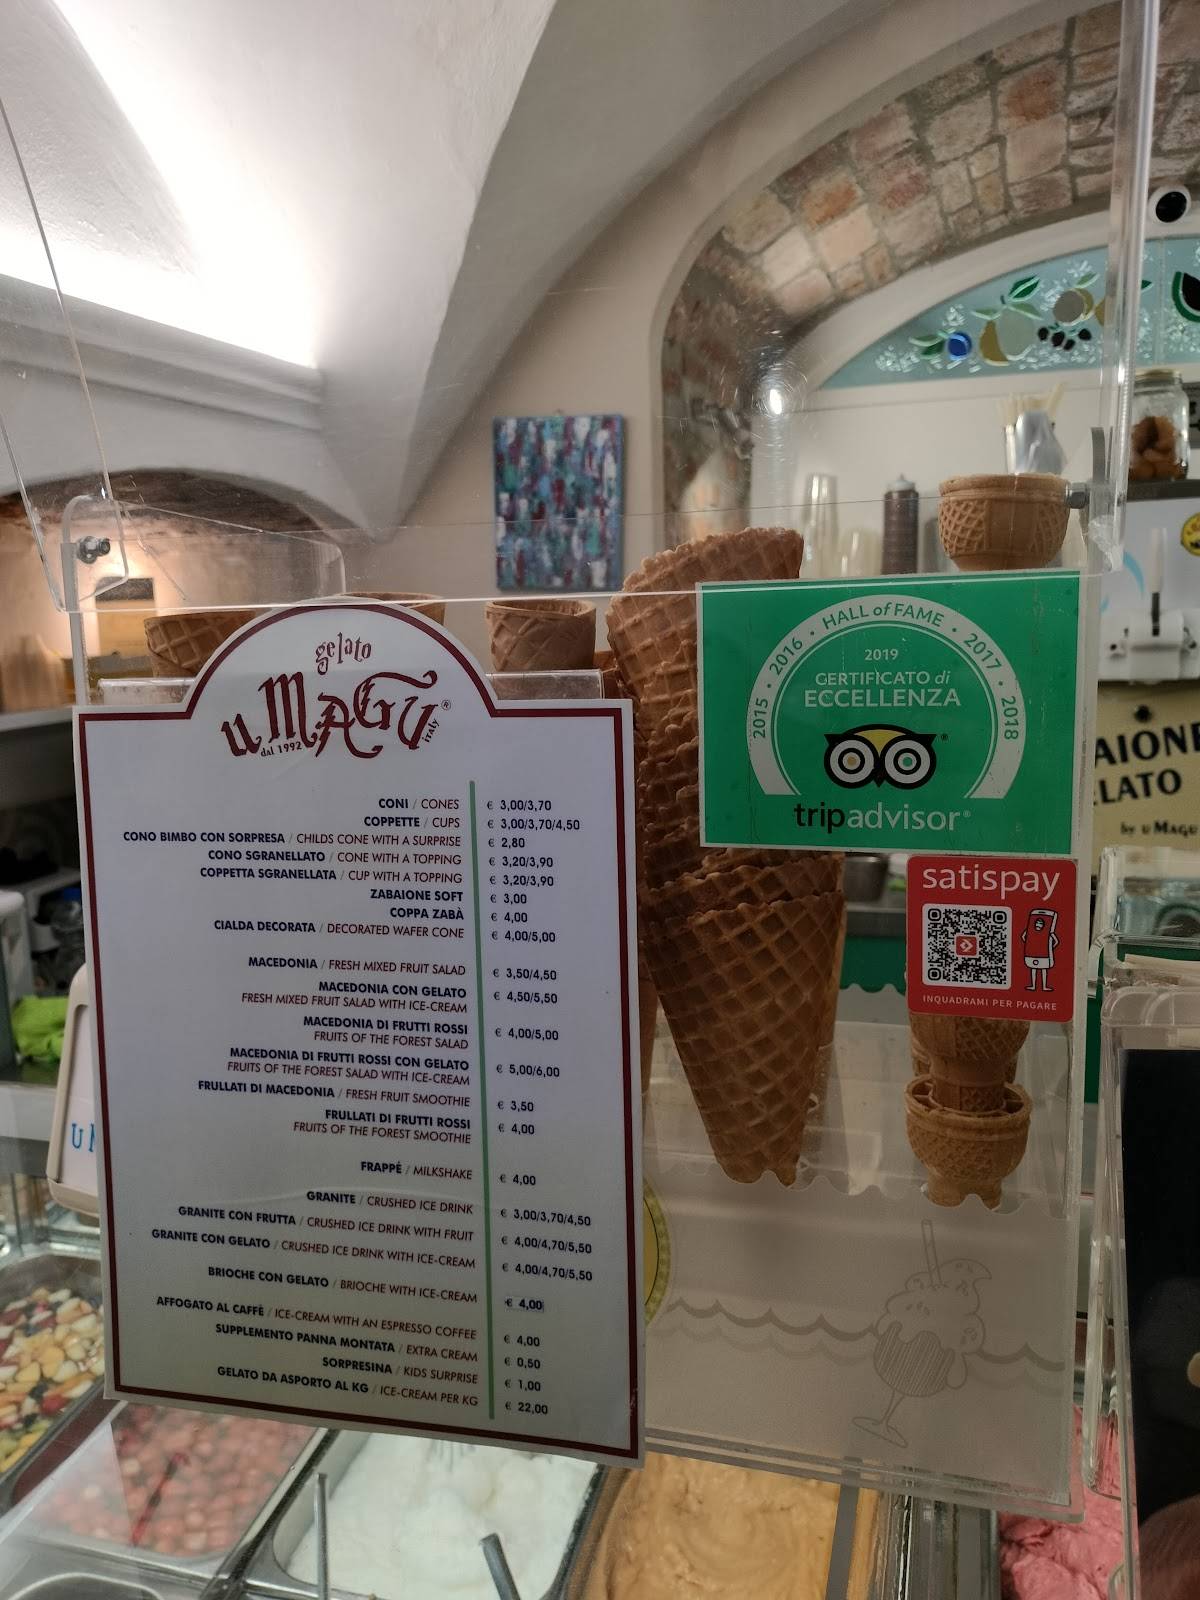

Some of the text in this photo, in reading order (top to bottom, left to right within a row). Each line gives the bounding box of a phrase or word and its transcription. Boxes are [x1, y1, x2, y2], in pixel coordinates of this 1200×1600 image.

[315, 632, 372, 675] gelato
[864, 649, 898, 660] 2019
[753, 602, 1018, 740] 2015 2016 HALL of FAME 2017 2018
[815, 670, 951, 686] CERTIFICATO di
[804, 688, 961, 708] ECCELLENZA
[278, 741, 302, 755] 1992
[378, 798, 459, 810] CONI CONES
[500, 800, 551, 812] 3,00/3,70
[364, 816, 420, 828] COPPETTE
[501, 818, 580, 831] 3,00/3,70/4,50
[124, 832, 461, 847] CONO BIMBO CON SORPRESA CHILDS CONE WITH A SURPRISE
[502, 837, 525, 849] 2,80
[208, 850, 462, 865] CONO SGRANELLATO CONE WITH A TOPPING
[502, 856, 554, 869] 3,20/3,90
[200, 867, 464, 883] COPPETTA SGRANELLATA CUP WITH A TOPPING
[502, 874, 554, 887] 3,20/3,90
[922, 864, 1060, 900] satispay
[370, 889, 464, 902] ZABAIONE SOFT
[504, 893, 527, 905] 3,00
[390, 907, 464, 920] COPPA ZABÀ
[504, 912, 528, 924] 4,00
[214, 920, 464, 938] CIALDA DECORATA DECORATED WAFER CONE
[504, 930, 556, 944] 4,00/5,00
[248, 957, 466, 976] MACEDONIA FRESH MIXED FRUIT SALAD
[506, 968, 556, 981] 3,50/4,50
[319, 981, 466, 998] MACEDONIA CON GELATO
[507, 991, 557, 1004] 4,50/5,50
[923, 994, 1057, 1010] INQUADRAMI PER PAGARE
[304, 1016, 469, 1035] MACEDONIA DI FRUTTI ROSSI
[508, 1027, 559, 1042] 4,00/5,00
[230, 1048, 469, 1071] MACEDONIA DI FRUTTI ROSSI CON GELATO
[509, 1064, 560, 1078] 5,00/6,00
[198, 1080, 470, 1107] FRULLATI DI MACEDONIA FRESH FRUIT SMOOTHIE
[510, 1100, 534, 1112] 3,50
[511, 1123, 534, 1135] 4,00
[413, 1166, 472, 1180] MILKSHAKE
[512, 1174, 536, 1186] 4,00
[306, 1191, 473, 1214] GRANITE CRUSHED ICE DRINK
[177, 1206, 474, 1241] GRANITE CON FRUTTA CRUSHED ICE DRINK WITH FRUIT
[514, 1209, 591, 1226] 3,00/3,70/4,50
[152, 1229, 475, 1268] GRANITE CON GELATO CRUSHED ICE DRINK WITH ICE-CREAM
[514, 1236, 592, 1254] 4,00/4,70/5,50
[515, 1263, 592, 1281] 4,00/4,70/5,50
[208, 1266, 477, 1303] BRIOCHE CON GELATO BRIOCHE WITH ICE-CREAM
[518, 1298, 544, 1312] 4,00
[216, 1323, 478, 1362] SUPPLEMENTO PANNA MONTATA EXTRA CREAM
[516, 1334, 540, 1348] 4,00
[322, 1357, 478, 1384] SORPRESINA KIDS SURPRISE
[517, 1357, 540, 1370] 0,50
[218, 1366, 478, 1406] GELATO DA ASPORTO AL KG ICE-CREAM PER KG
[518, 1379, 541, 1392] 1,00
[518, 1401, 548, 1416] 22,00
